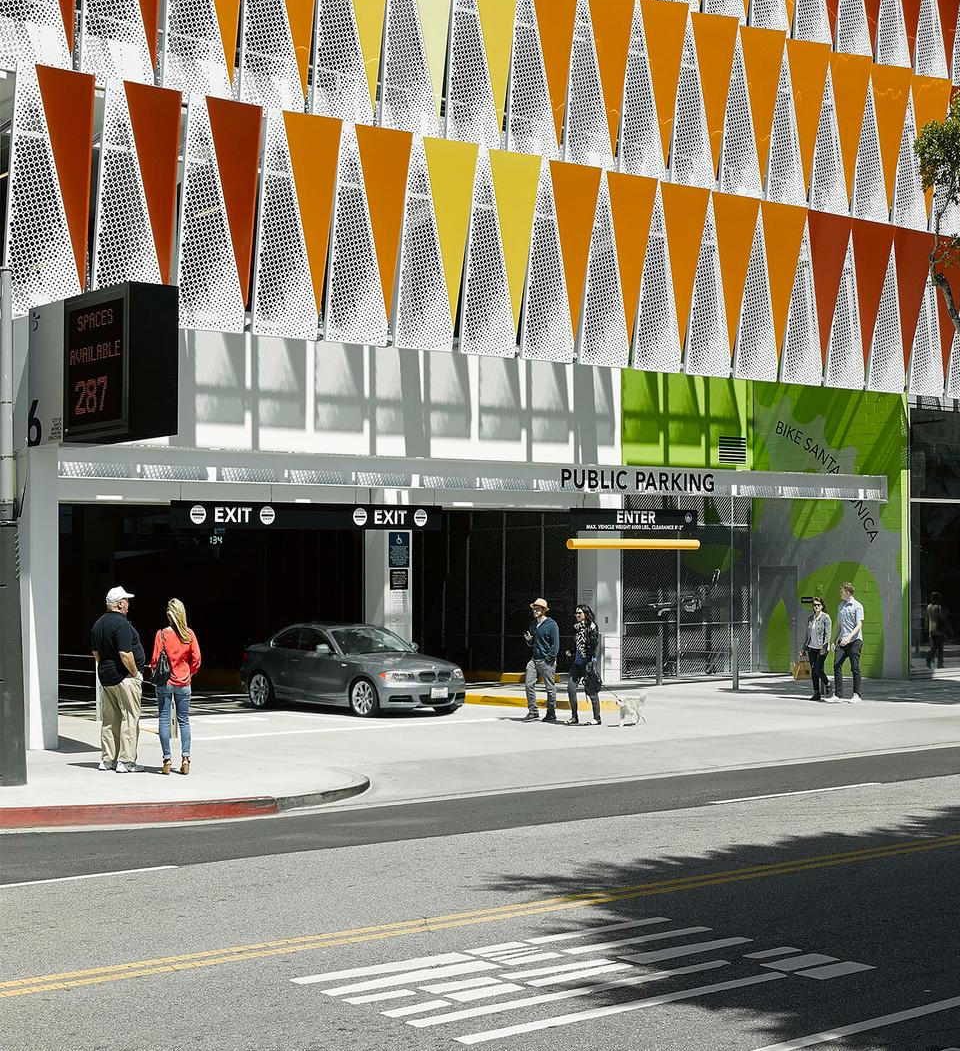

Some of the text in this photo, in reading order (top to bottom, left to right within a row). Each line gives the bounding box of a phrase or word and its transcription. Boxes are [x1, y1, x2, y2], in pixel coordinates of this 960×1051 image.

[76, 308, 114, 332] SPACES
[69, 339, 121, 366] AVAILABLE
[75, 376, 108, 415] 287
[560, 468, 715, 493] PUBLIC PARKING
[775, 420, 879, 543] BIKE SANTA NICA
[214, 506, 253, 523] EXIT
[374, 509, 408, 525] EXIT
[616, 510, 656, 524] ENTER
